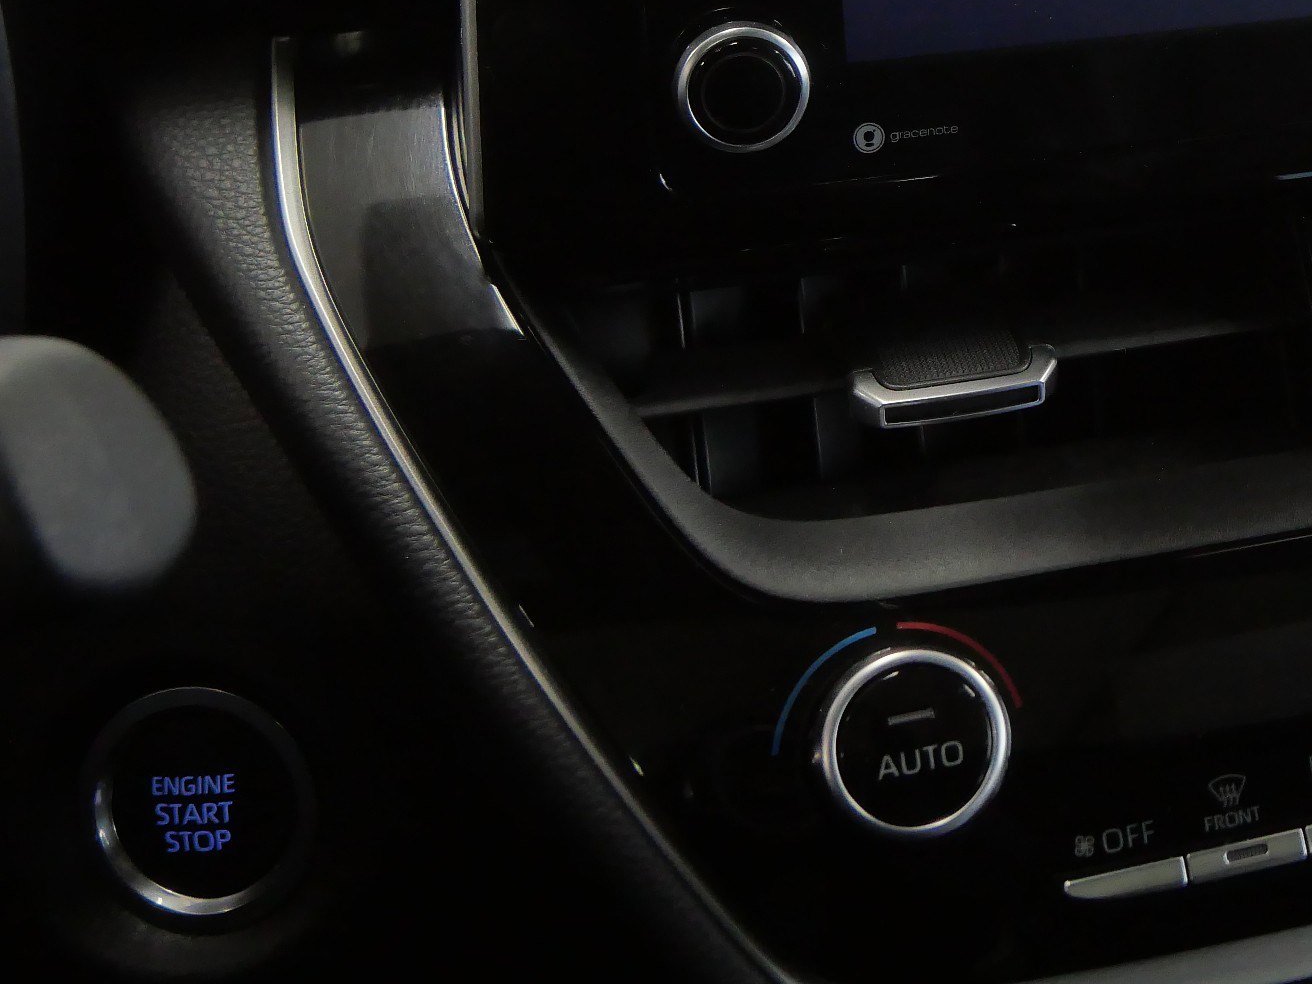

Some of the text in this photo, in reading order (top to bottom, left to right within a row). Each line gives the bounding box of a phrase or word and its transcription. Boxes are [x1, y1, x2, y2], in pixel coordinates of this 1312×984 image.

[890, 125, 959, 143] gracenote
[878, 740, 964, 781] AUTO
[151, 773, 235, 796] ENGINE
[154, 801, 233, 826] START
[1204, 806, 1260, 832] FRONT
[164, 829, 232, 853] STOP
[1101, 820, 1156, 855] OFF
